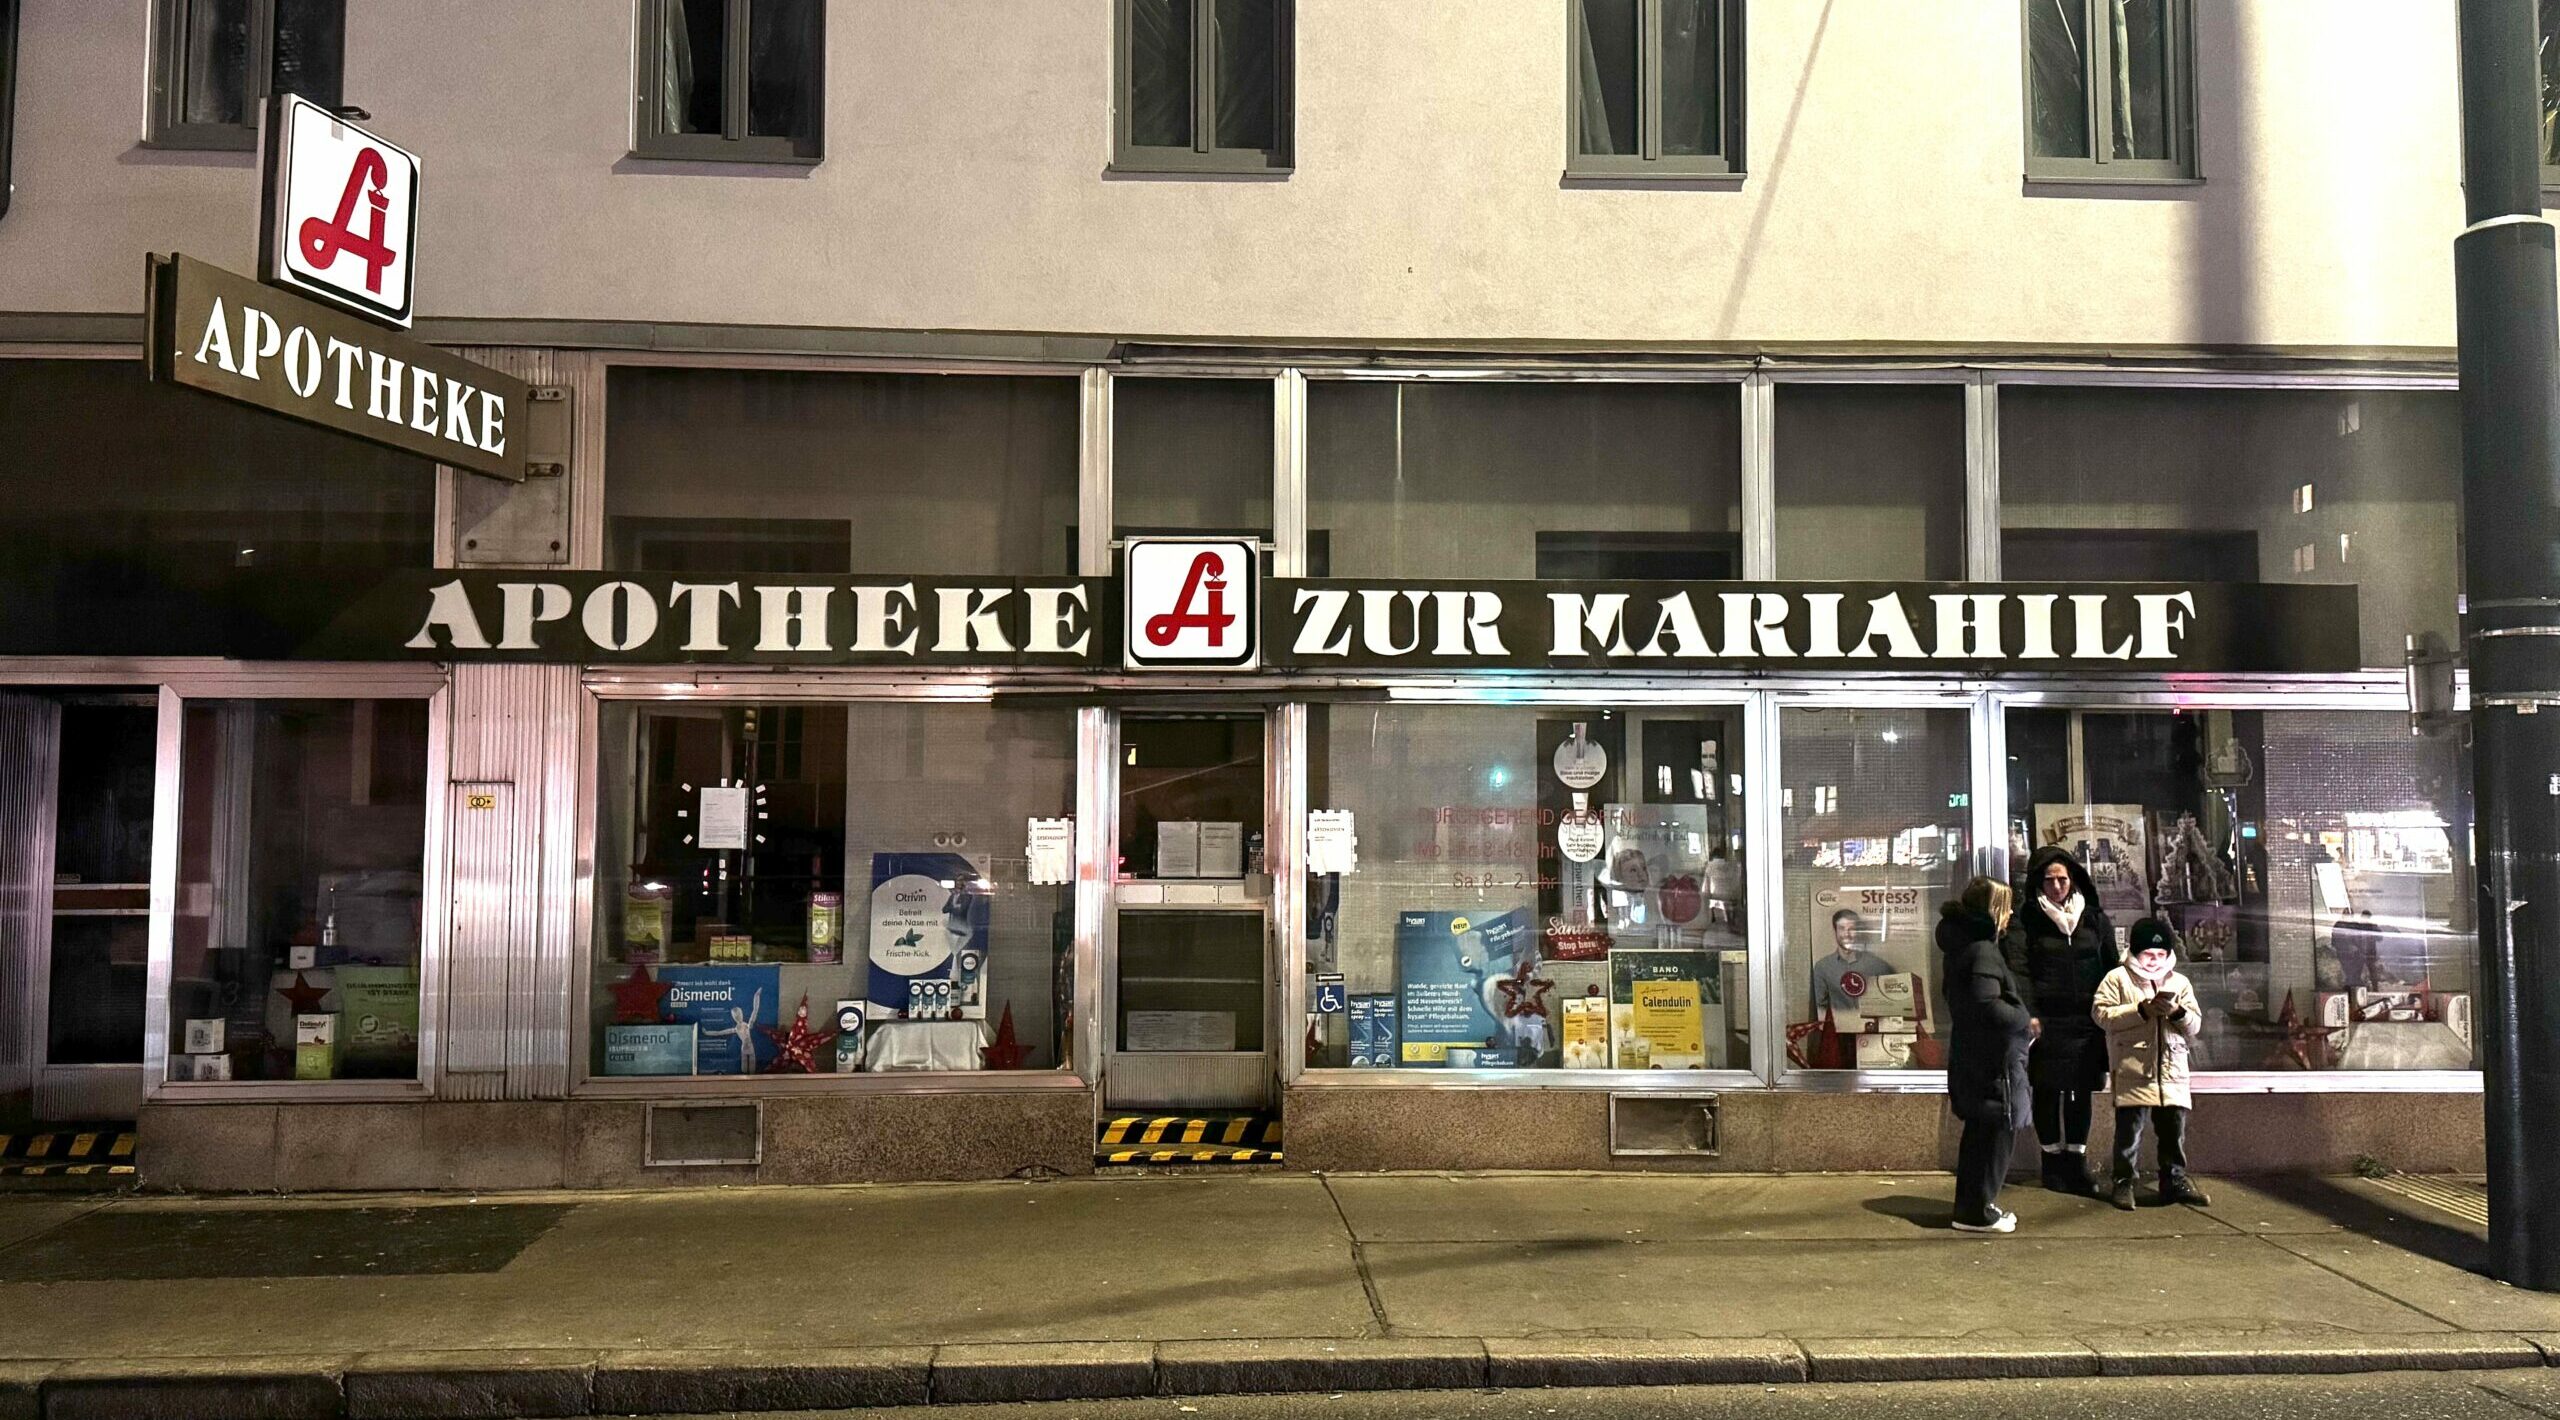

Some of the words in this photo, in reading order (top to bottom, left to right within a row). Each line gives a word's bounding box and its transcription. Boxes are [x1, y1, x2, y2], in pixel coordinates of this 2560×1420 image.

[194, 296, 507, 458] APOTHEKE
[404, 578, 1092, 656] APOTHEKE
[1292, 588, 1511, 657] ZUR
[1546, 590, 2196, 660] MARIAHILF
[1483, 872, 1493, 889] 8
[896, 889, 927, 902] Otrivin
[1861, 888, 1918, 904] Stress?
[1862, 906, 1878, 915] Nur
[905, 919, 925, 927] Nase
[926, 919, 938, 927] mit
[1558, 941, 1577, 951] Stop
[1652, 966, 1679, 974] BANO
[1642, 995, 1692, 1008] Calendulin
